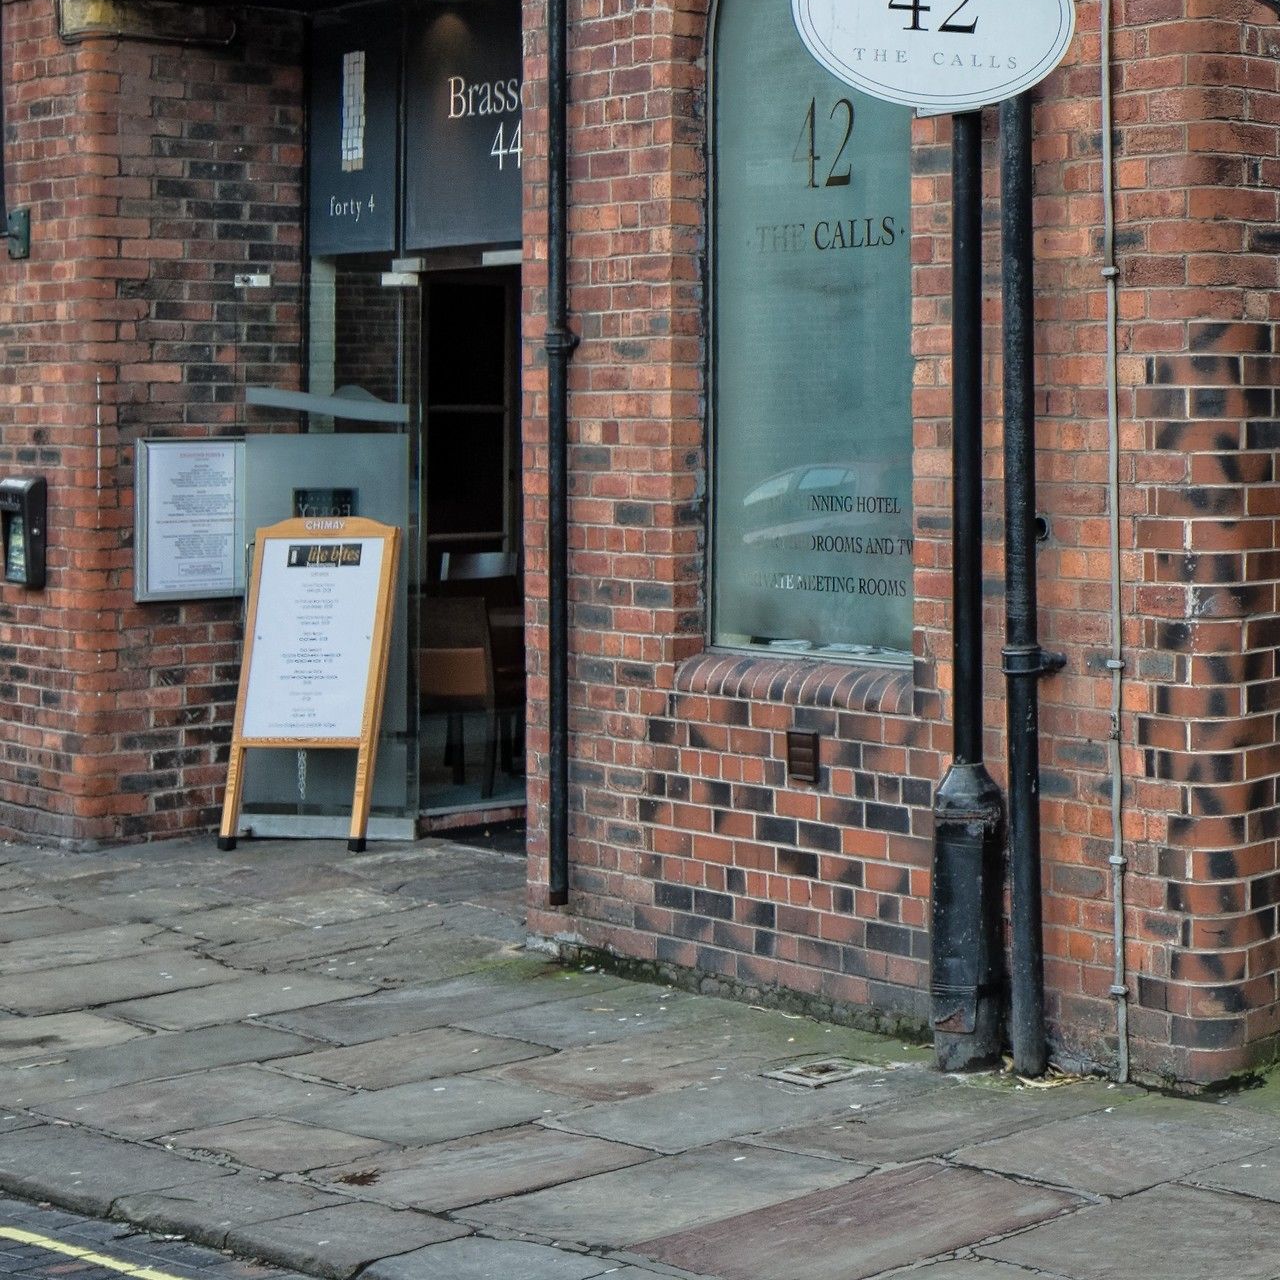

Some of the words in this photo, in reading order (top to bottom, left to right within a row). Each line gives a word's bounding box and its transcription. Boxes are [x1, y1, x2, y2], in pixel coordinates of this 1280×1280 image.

[852, 47, 908, 64] THE
[933, 52, 1018, 70] CALLS
[448, 76, 522, 119] Brass
[490, 120, 523, 170] 44
[792, 97, 855, 189] 42
[329, 194, 362, 223] forty
[368, 193, 375, 213] 4
[755, 223, 806, 254] THE
[814, 216, 896, 250] CALLS
[856, 496, 901, 514] HOTEL
[305, 520, 346, 530] CHIMAY
[866, 537, 894, 555] AND
[797, 575, 855, 594] MEETING
[858, 578, 907, 597] ROOMS
